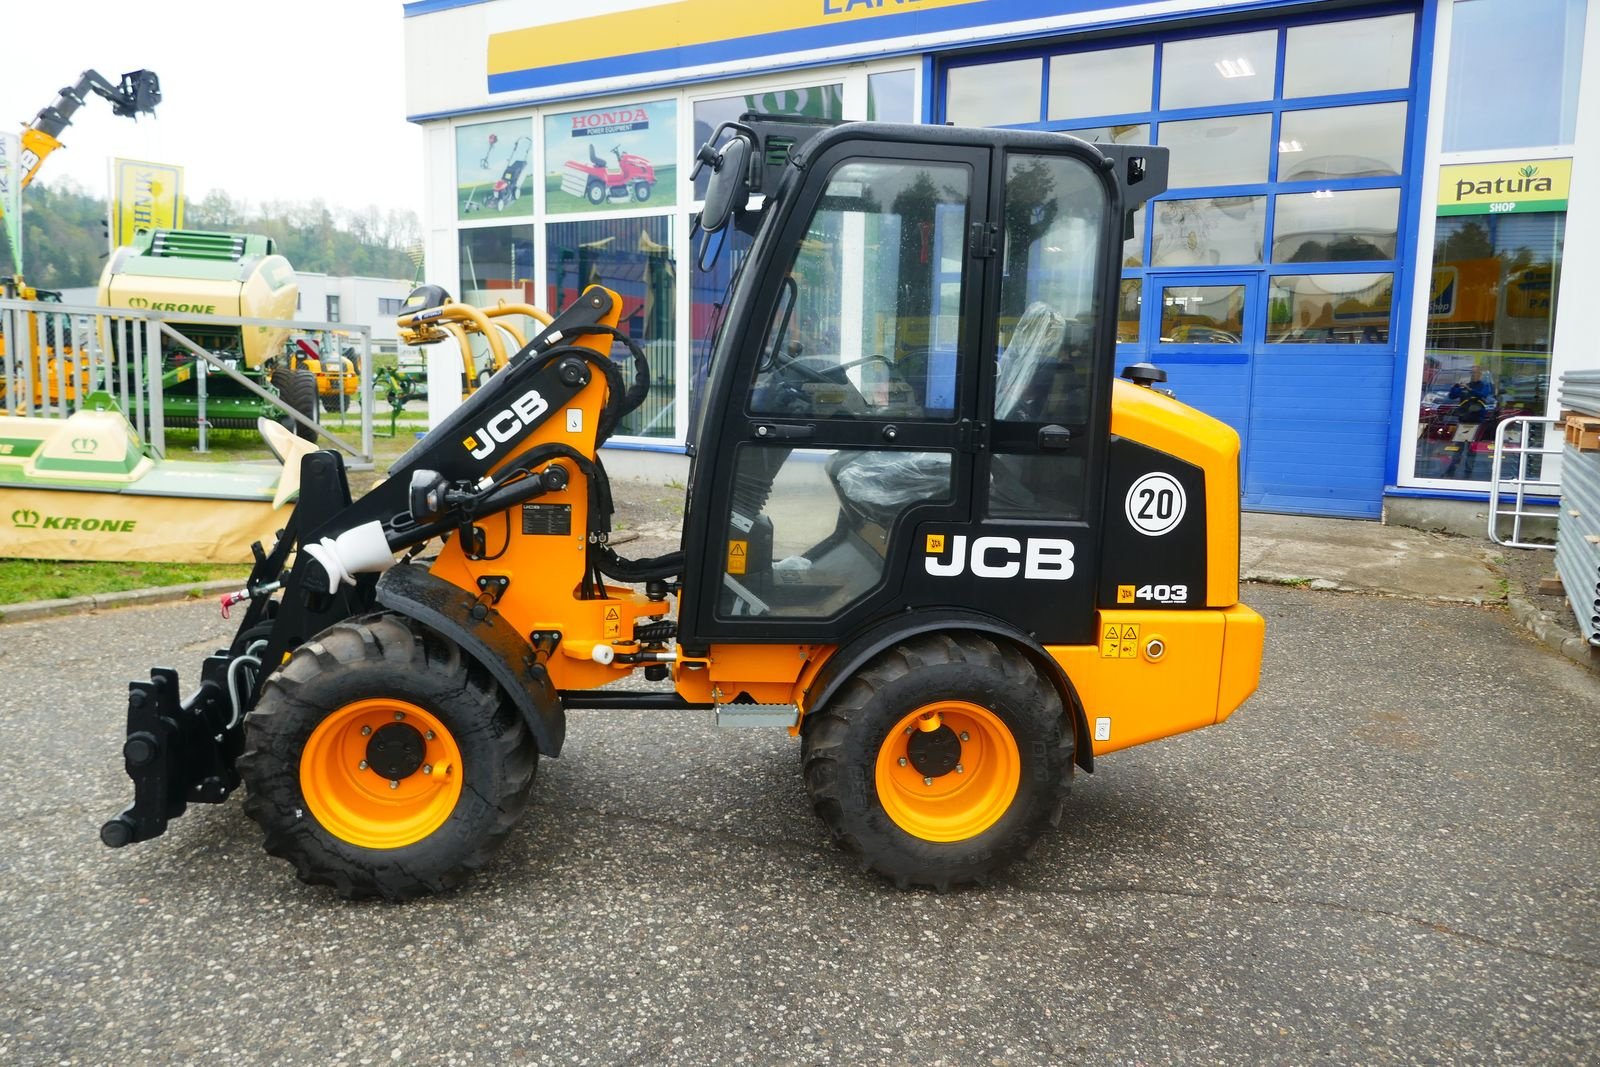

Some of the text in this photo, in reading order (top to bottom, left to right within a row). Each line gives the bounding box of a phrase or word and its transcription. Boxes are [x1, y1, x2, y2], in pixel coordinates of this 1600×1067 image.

[823, 0, 922, 15] LA
[572, 109, 649, 129] HONDA
[586, 123, 633, 136] POWER EQUIPMENT
[1456, 176, 1552, 201] patura
[1489, 202, 1516, 213] SHOP
[151, 302, 216, 315] KRONE
[470, 389, 548, 460] JCB
[1138, 489, 1173, 519] 20
[42, 516, 137, 532] KRONE
[924, 534, 1075, 581] JCB
[1136, 584, 1188, 601] 403
